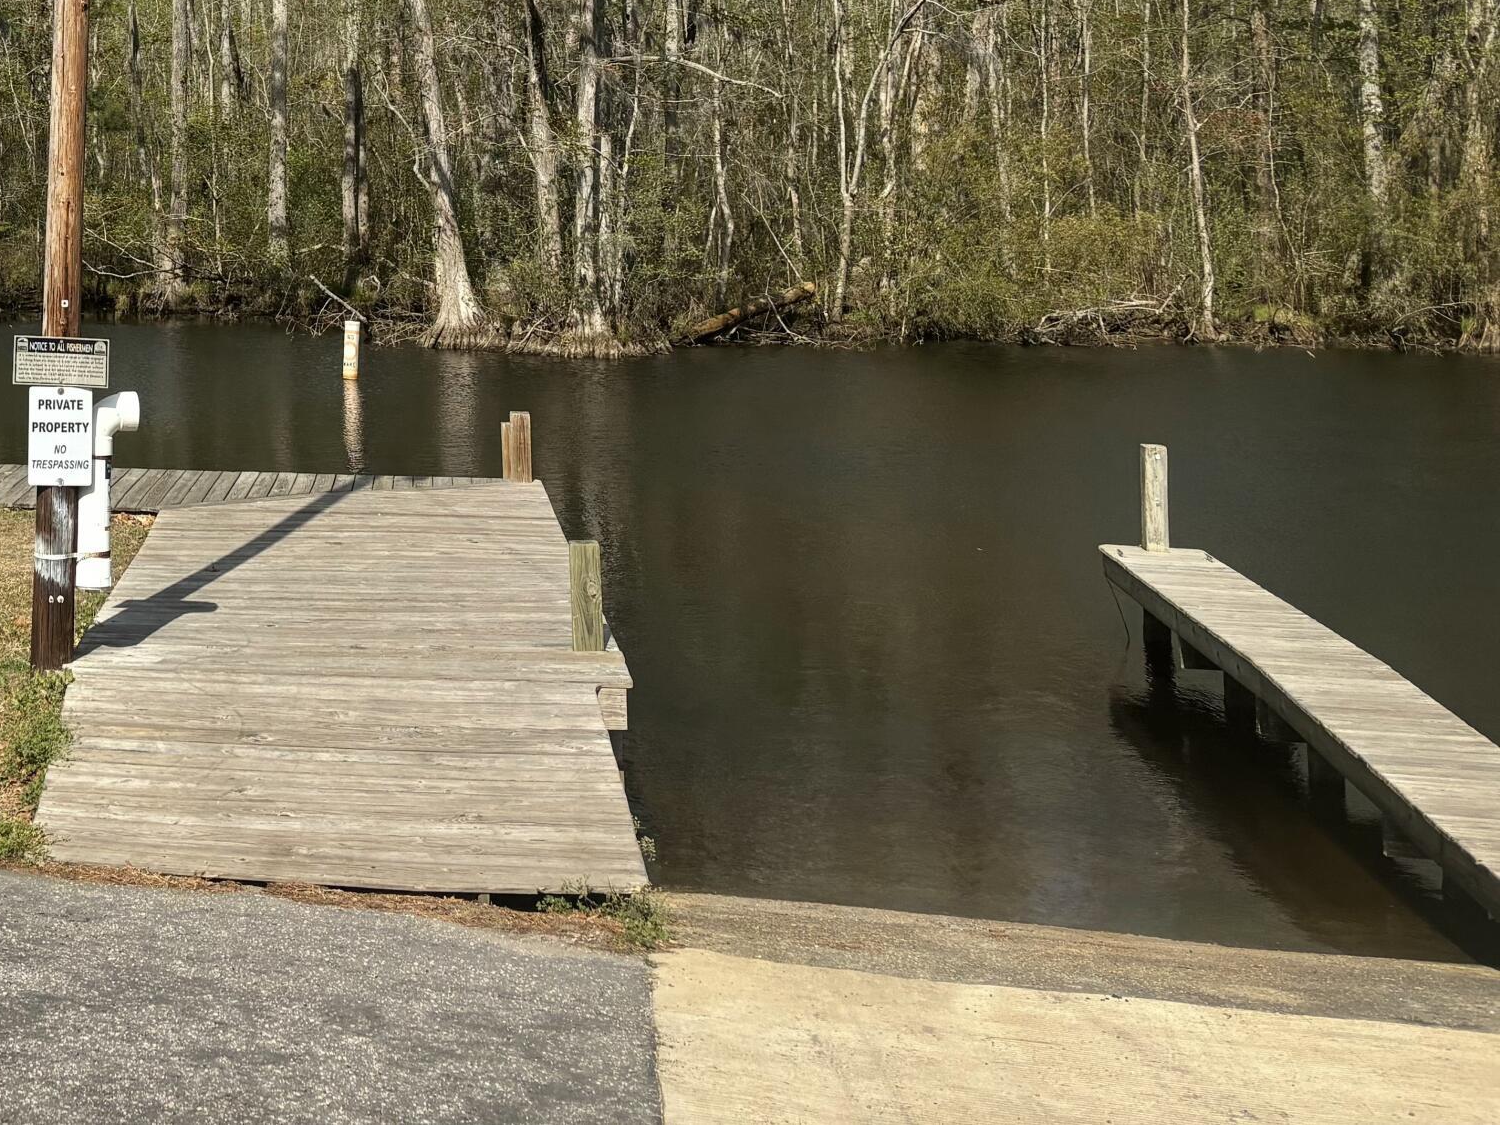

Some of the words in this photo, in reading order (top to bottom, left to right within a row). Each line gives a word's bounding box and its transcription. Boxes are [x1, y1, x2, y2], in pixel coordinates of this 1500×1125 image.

[29, 341, 47, 351] NOTICE
[49, 342, 56, 351] TO
[57, 342, 65, 352] ALL
[66, 343, 93, 353] FISHERMEN
[38, 399, 84, 411] PRIVATE
[32, 421, 90, 434] PROPERTY
[53, 444, 67, 455] NO
[32, 459, 90, 470] TRESPASSING
